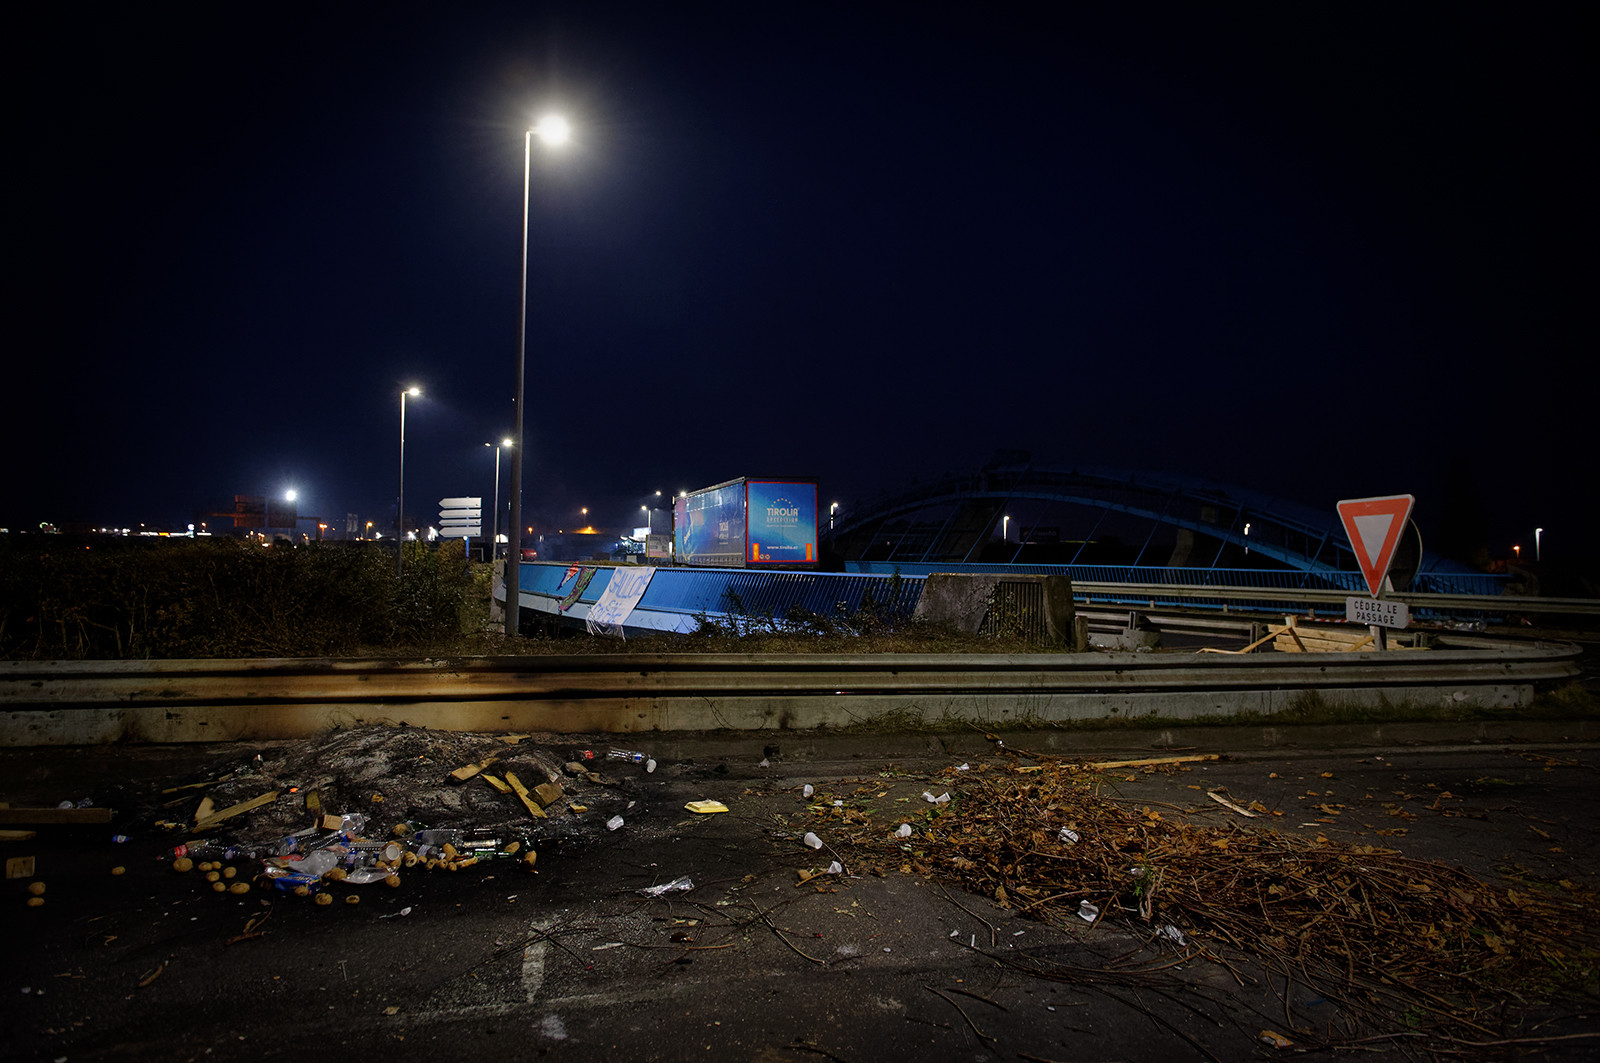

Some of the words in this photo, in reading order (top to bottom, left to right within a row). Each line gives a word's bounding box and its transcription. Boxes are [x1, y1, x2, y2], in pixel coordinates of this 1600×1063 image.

[767, 508, 798, 516] TIROLIA
[1354, 600, 1381, 613] CÉDEZ
[1387, 604, 1397, 614] LE
[1356, 612, 1395, 625] PASSAGE
